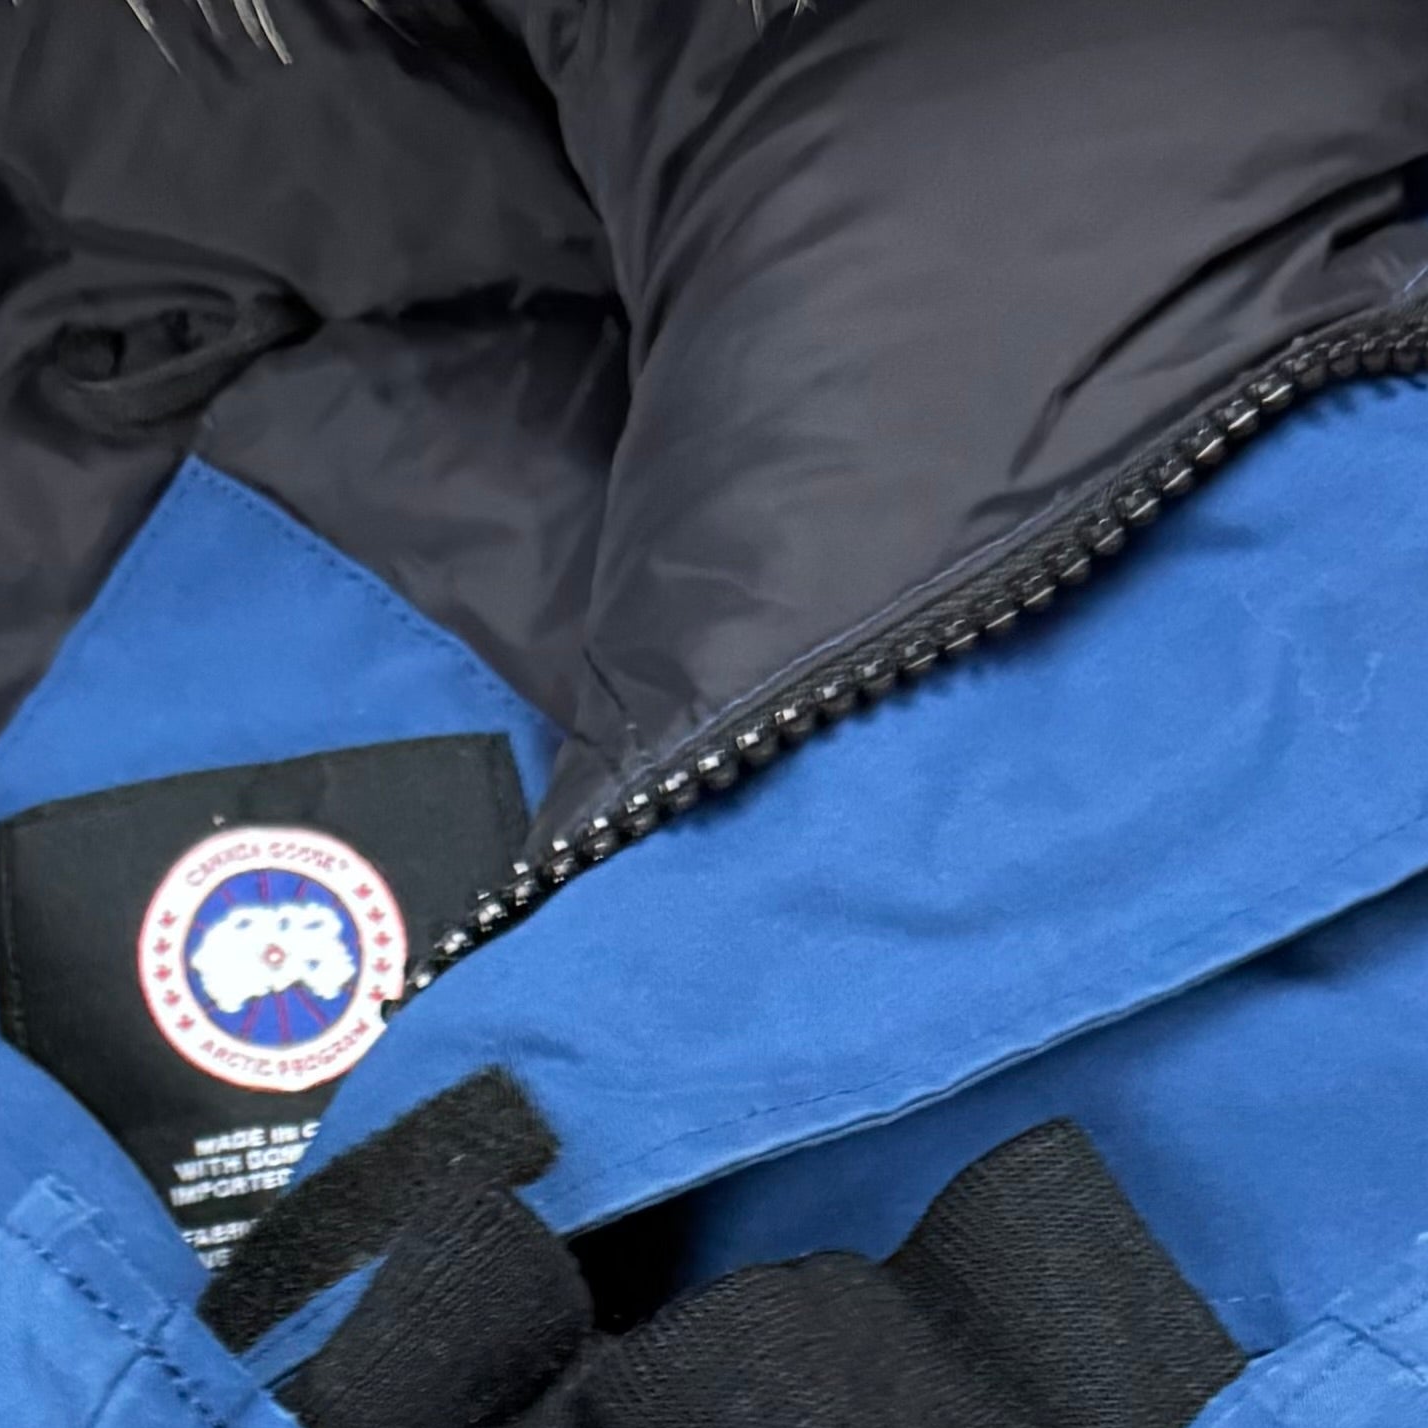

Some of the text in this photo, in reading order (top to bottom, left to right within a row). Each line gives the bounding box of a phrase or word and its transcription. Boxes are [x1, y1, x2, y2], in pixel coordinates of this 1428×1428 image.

[185, 842, 261, 887] CANADA
[200, 1019, 370, 1077] ARCTIC PROGRAM
[173, 1141, 312, 1182] WITH DOM
[194, 1127, 267, 1157] MADE
[270, 1126, 299, 1144] IN
